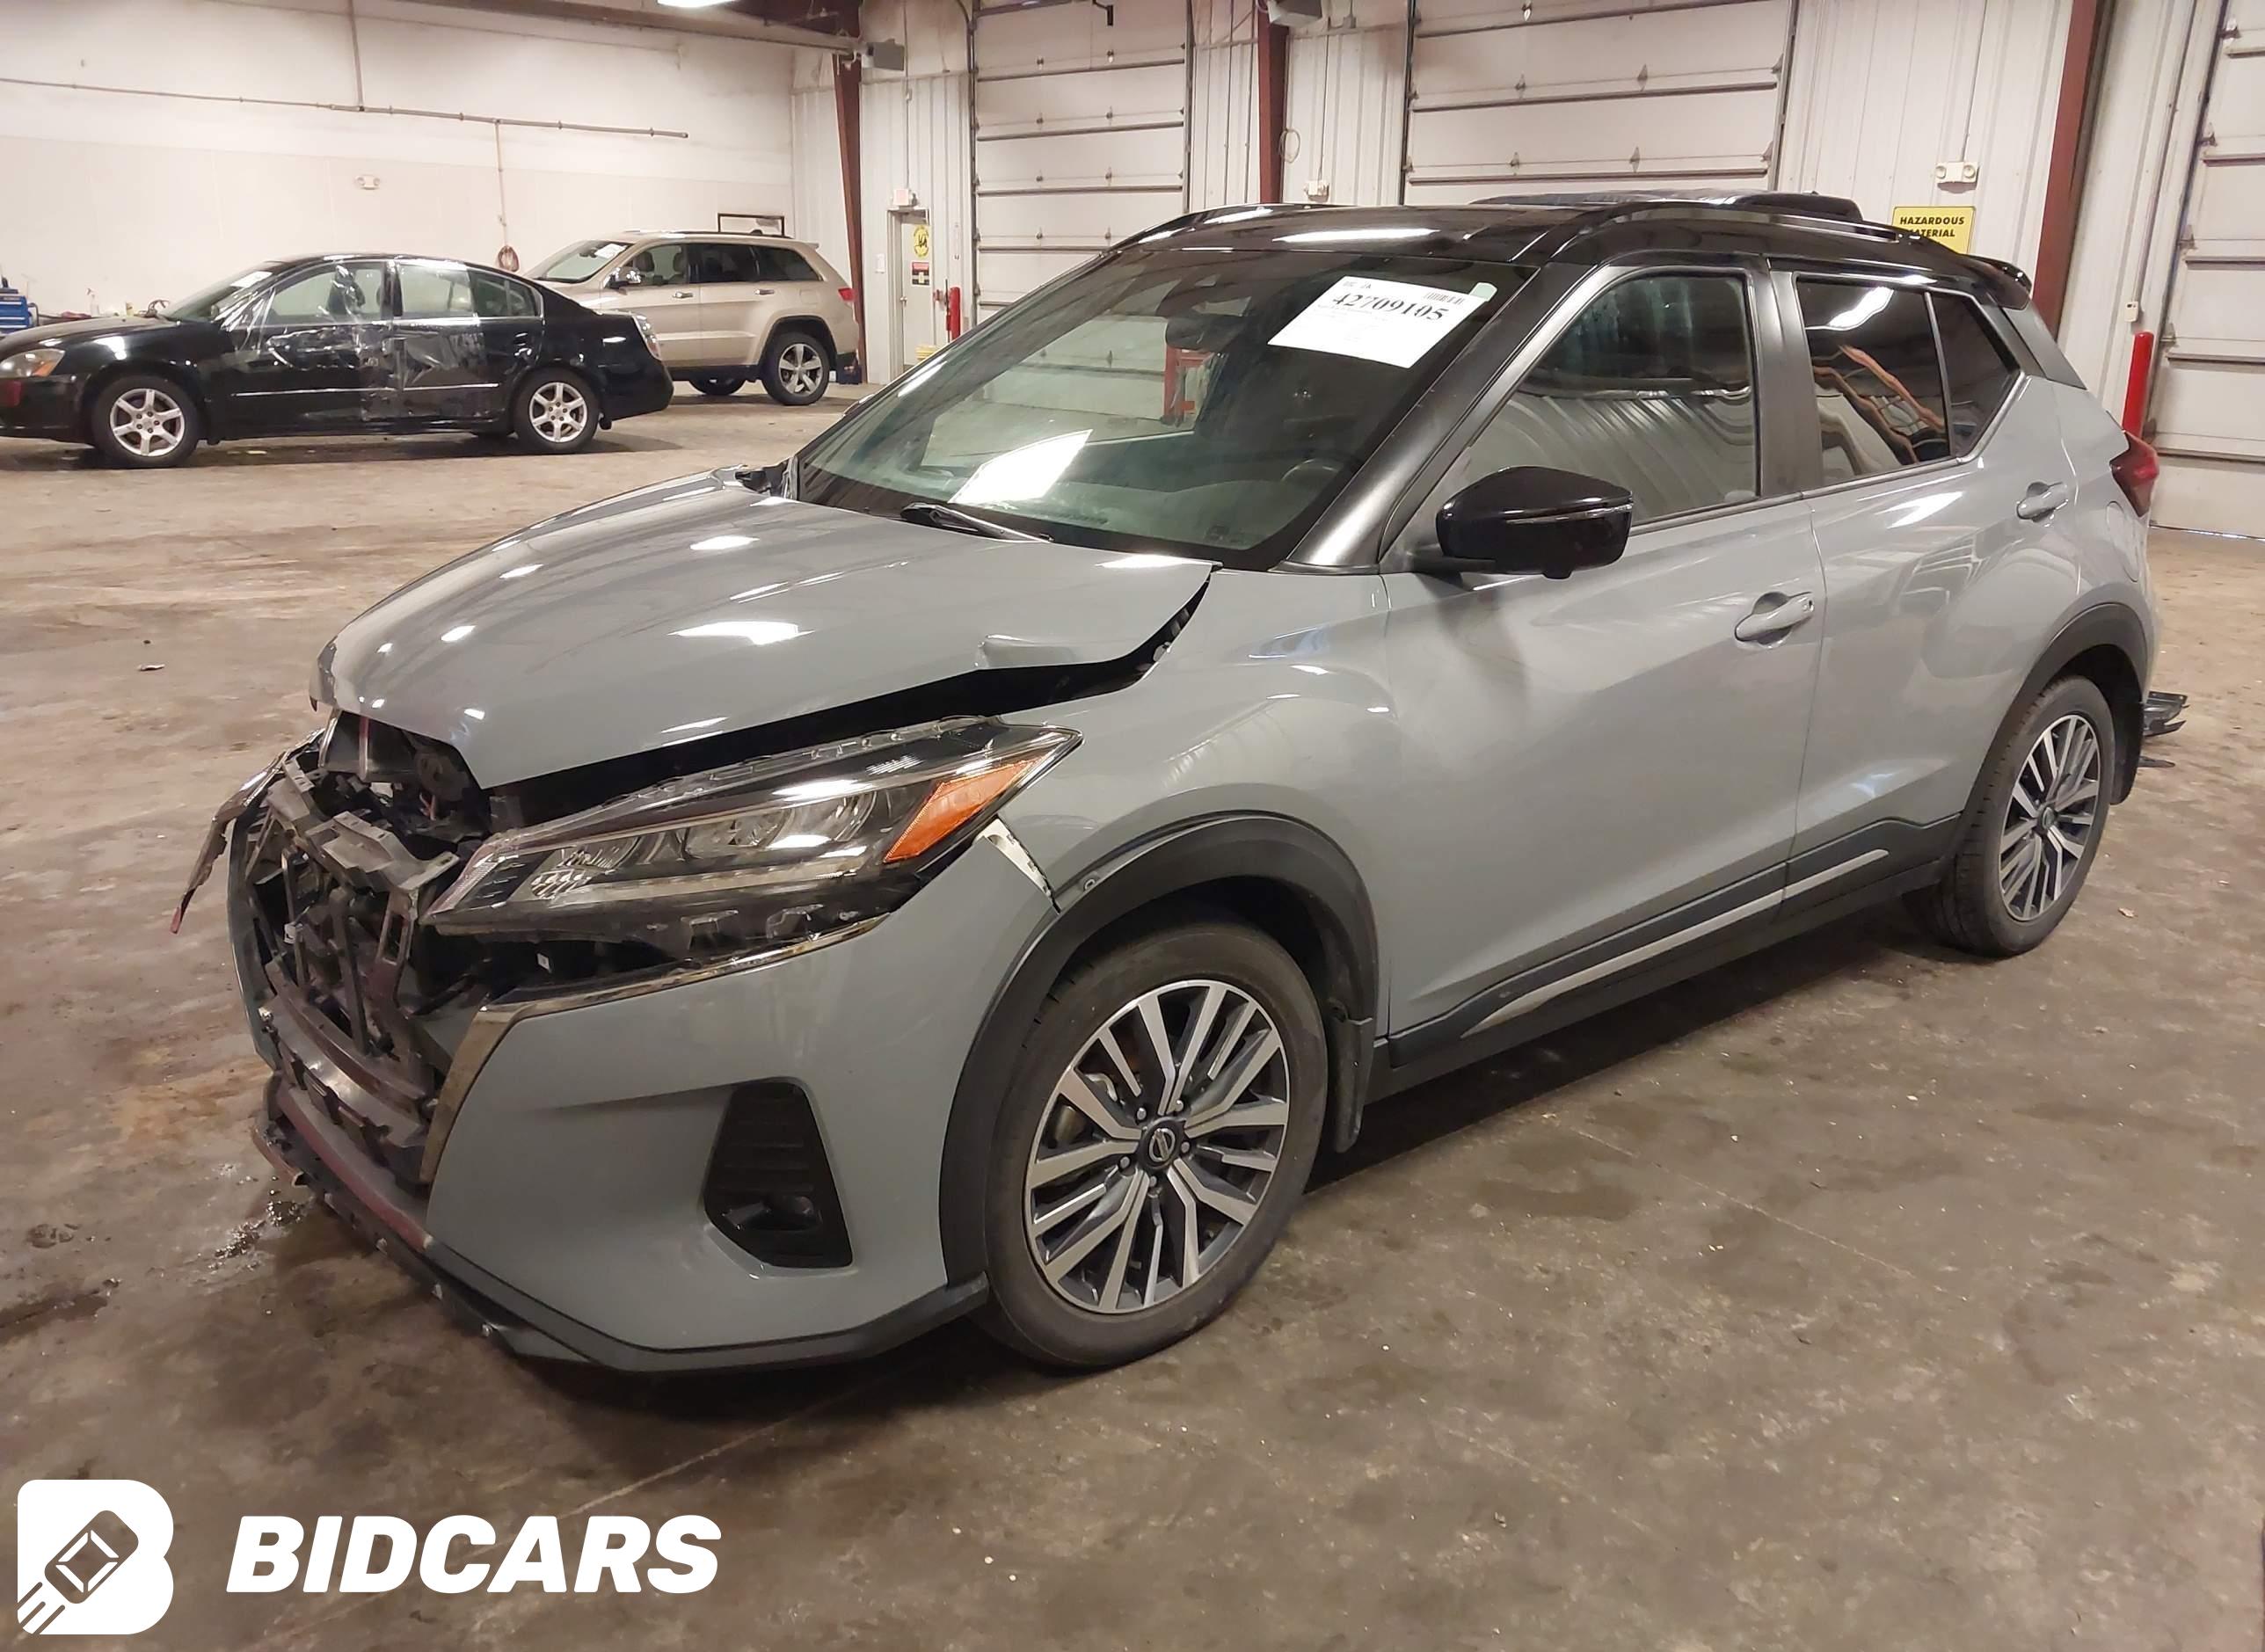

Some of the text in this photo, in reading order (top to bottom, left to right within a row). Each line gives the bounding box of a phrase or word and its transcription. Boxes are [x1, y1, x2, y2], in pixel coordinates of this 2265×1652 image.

[1899, 216, 1965, 225] HAZARDOUS
[1910, 229, 1955, 237] ATERIAL
[1332, 292, 1450, 321] 42709105
